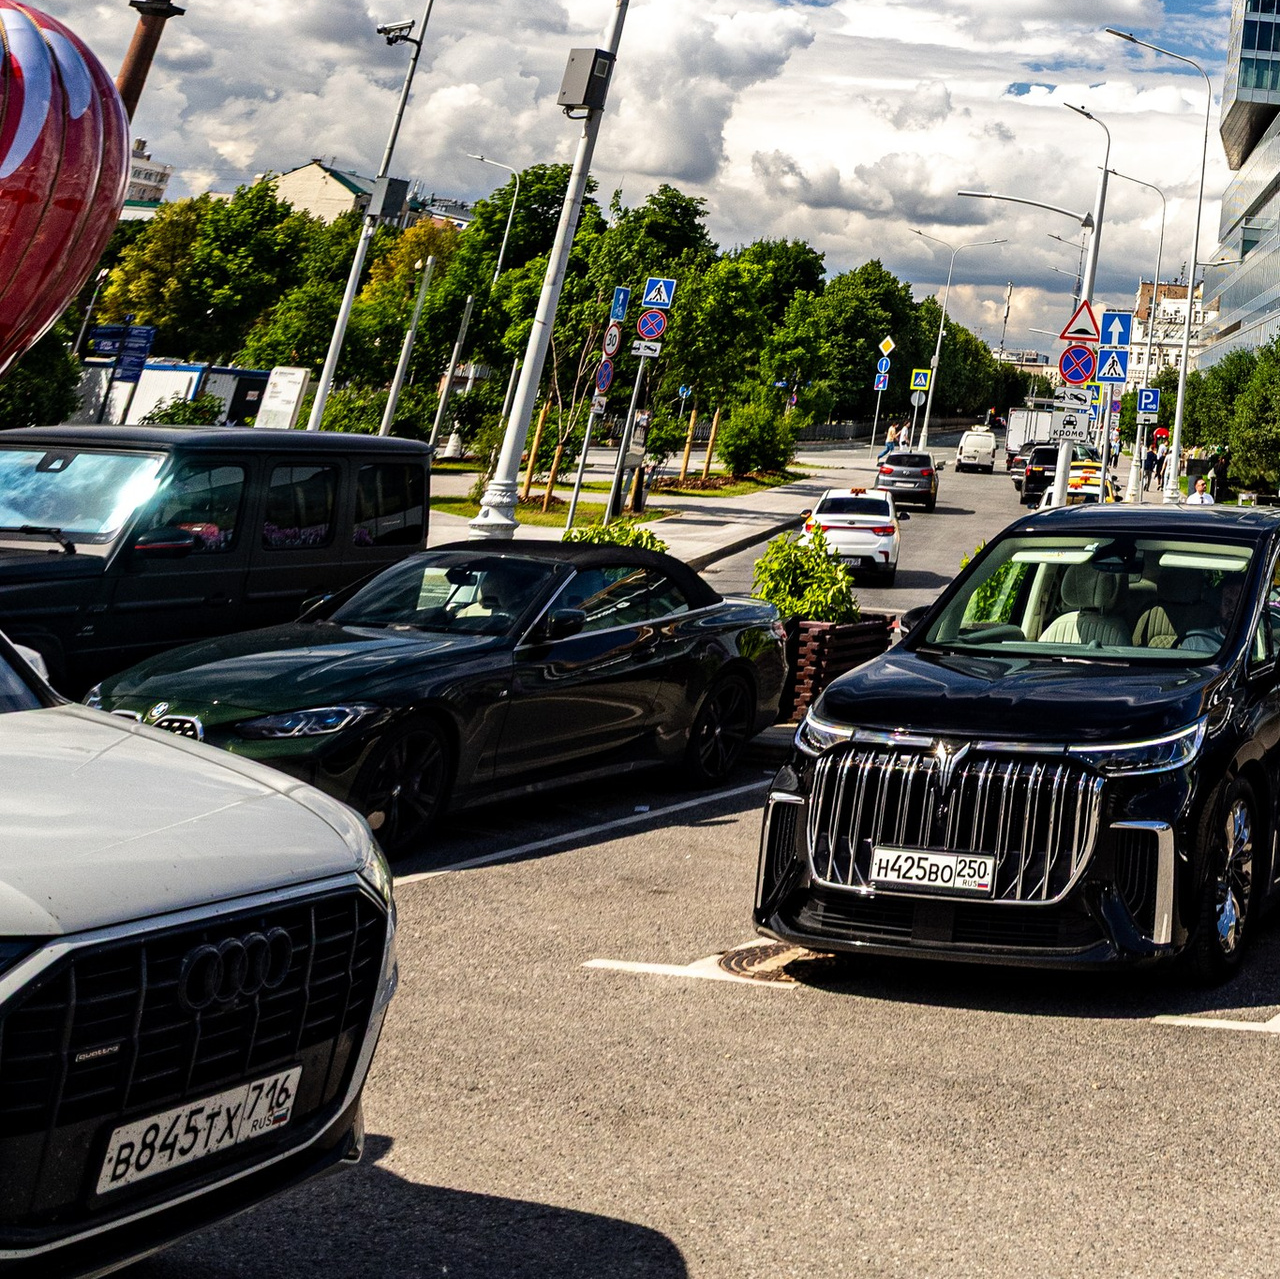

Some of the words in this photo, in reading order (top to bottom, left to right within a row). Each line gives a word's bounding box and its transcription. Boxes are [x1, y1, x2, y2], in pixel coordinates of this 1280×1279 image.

[606, 333, 617, 347] 30
[1053, 428, 1084, 439] кроме
[957, 859, 988, 879] 250
[962, 879, 978, 887] RUS
[78, 1046, 119, 1060] quattro
[247, 1074, 291, 1120] 716
[251, 1115, 273, 1132] RUS
